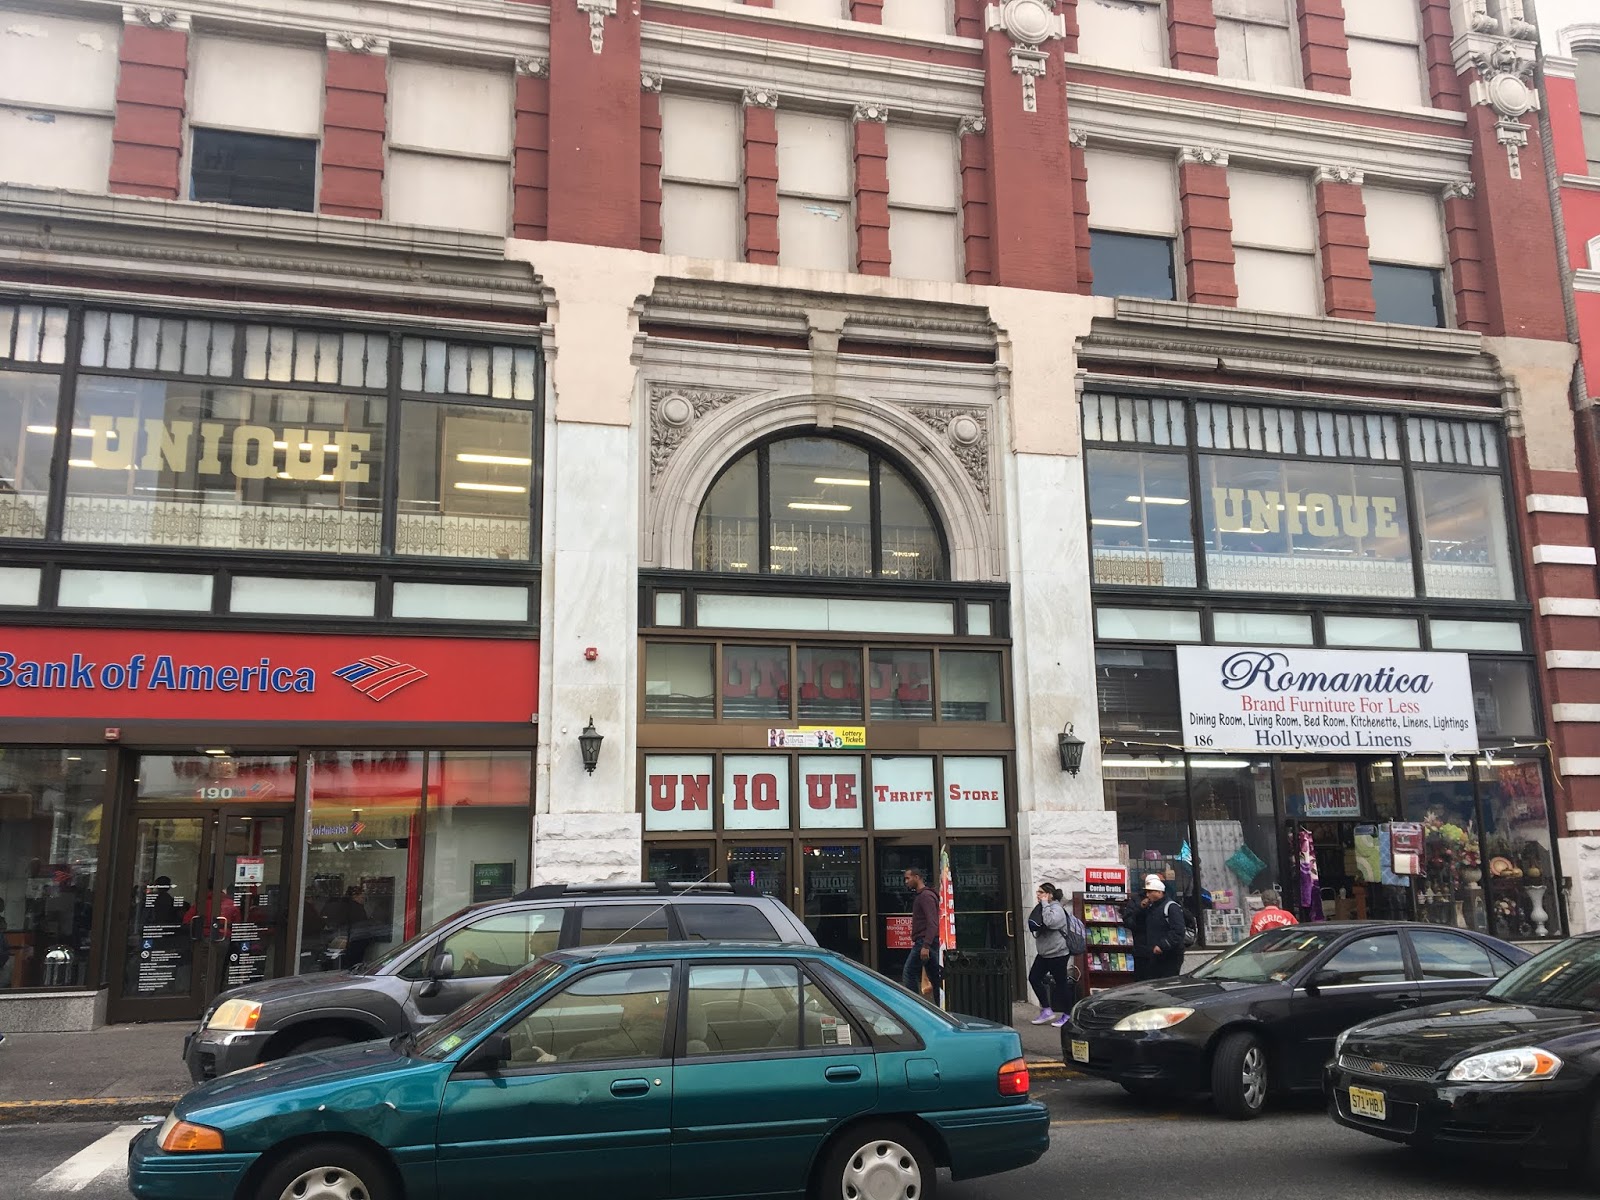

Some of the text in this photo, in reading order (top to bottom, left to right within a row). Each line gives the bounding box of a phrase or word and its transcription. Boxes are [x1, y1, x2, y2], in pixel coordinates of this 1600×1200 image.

[90, 415, 371, 483] UNIQUE
[1212, 487, 1400, 538] UNIQUE
[0, 651, 316, 693] Bank of America
[1220, 650, 1434, 694] Romantica
[1241, 694, 1420, 714] Brand Furniture For Less
[1189, 712, 1217, 728] Dining
[1219, 714, 1246, 727] Room,
[1248, 713, 1274, 728] Living
[1275, 715, 1302, 728] Room,
[1303, 715, 1322, 727] Bed
[1350, 715, 1400, 729] Kitchenette,
[1403, 716, 1432, 729] Linens,
[1433, 717, 1469, 730] Lightings
[1194, 730, 1412, 750] 186 Hollywood Linens
[196, 787, 233, 799] 190
[1305, 787, 1356, 808] VOUCHERS
